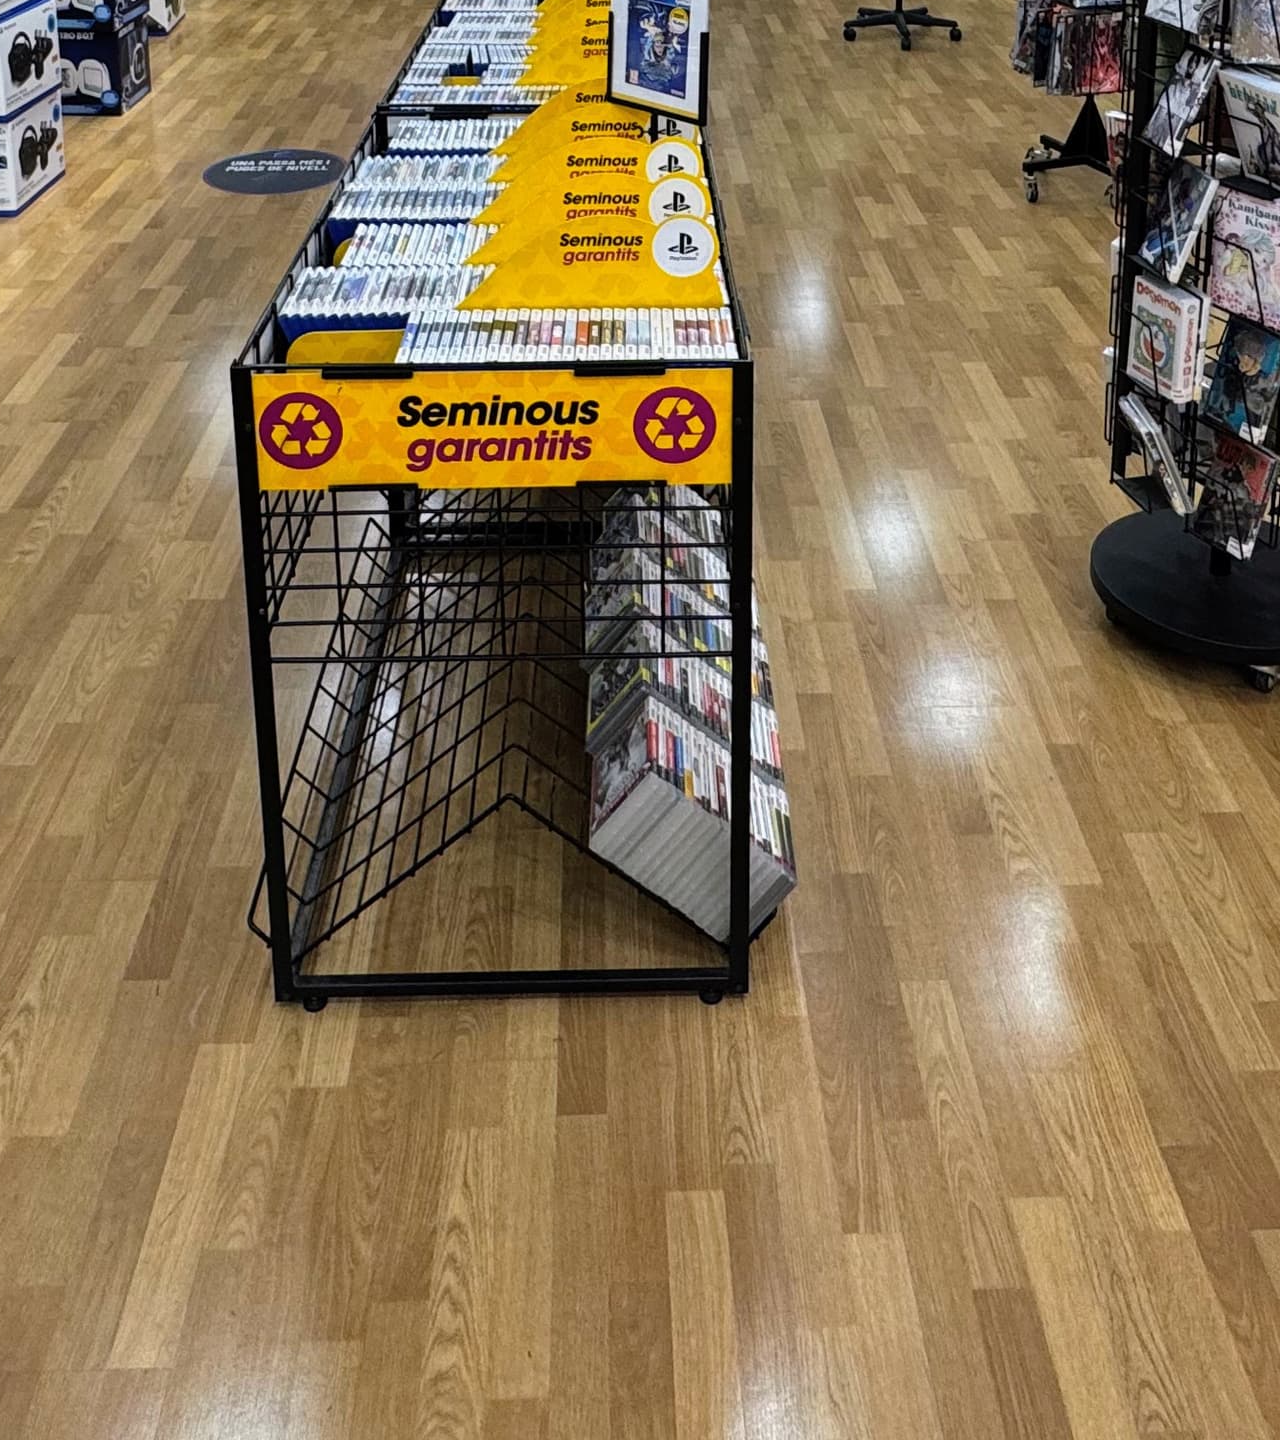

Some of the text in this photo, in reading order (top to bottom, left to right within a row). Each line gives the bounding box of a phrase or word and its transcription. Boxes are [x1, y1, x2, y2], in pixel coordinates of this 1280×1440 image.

[571, 120, 639, 132] Seminous
[567, 155, 638, 168] Seminous
[562, 191, 640, 206] Seminous
[1245, 215, 1271, 229] Kiss
[559, 232, 643, 249] Seminous
[562, 247, 640, 265] garantits
[397, 394, 600, 428] Seminous
[407, 429, 592, 472] garantits
